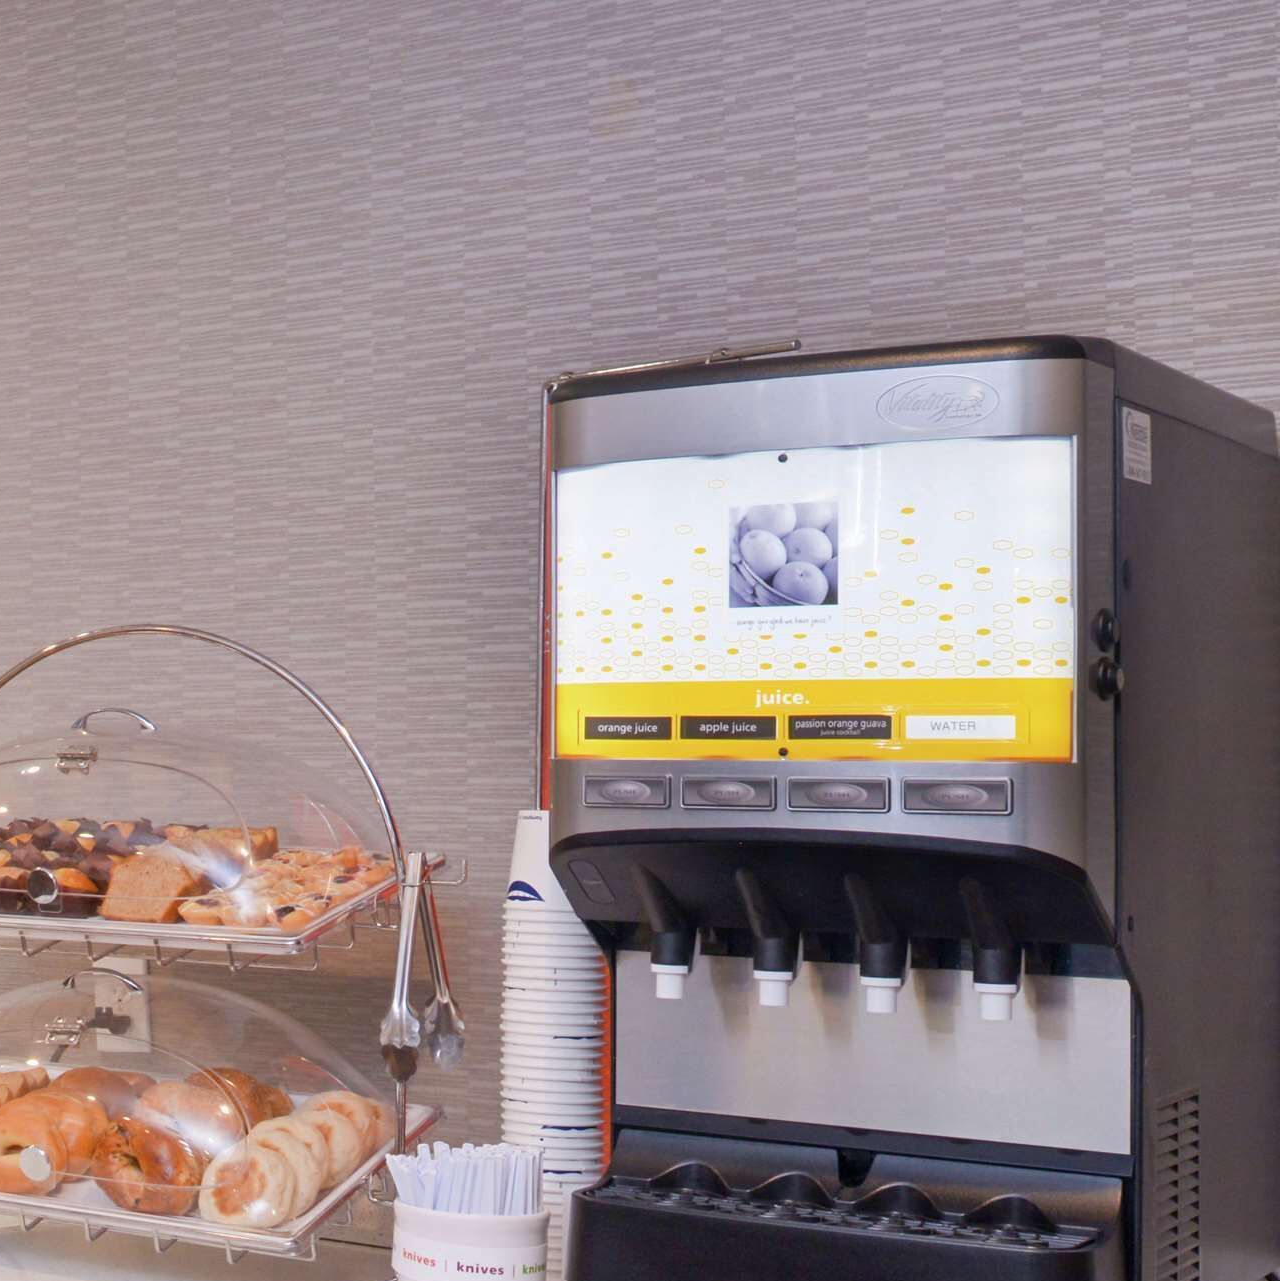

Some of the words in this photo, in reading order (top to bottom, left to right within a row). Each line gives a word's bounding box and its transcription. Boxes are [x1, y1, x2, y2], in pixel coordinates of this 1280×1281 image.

[755, 689, 810, 708] juice.
[597, 724, 632, 735] orange
[634, 722, 658, 734] juice
[699, 722, 729, 734] apple
[731, 721, 757, 734] juice
[795, 718, 826, 729] passion
[827, 719, 858, 729] orange
[860, 719, 887, 729] guava
[930, 720, 977, 731] WATER
[403, 1248, 436, 1268] knives
[457, 1261, 505, 1275] knives
